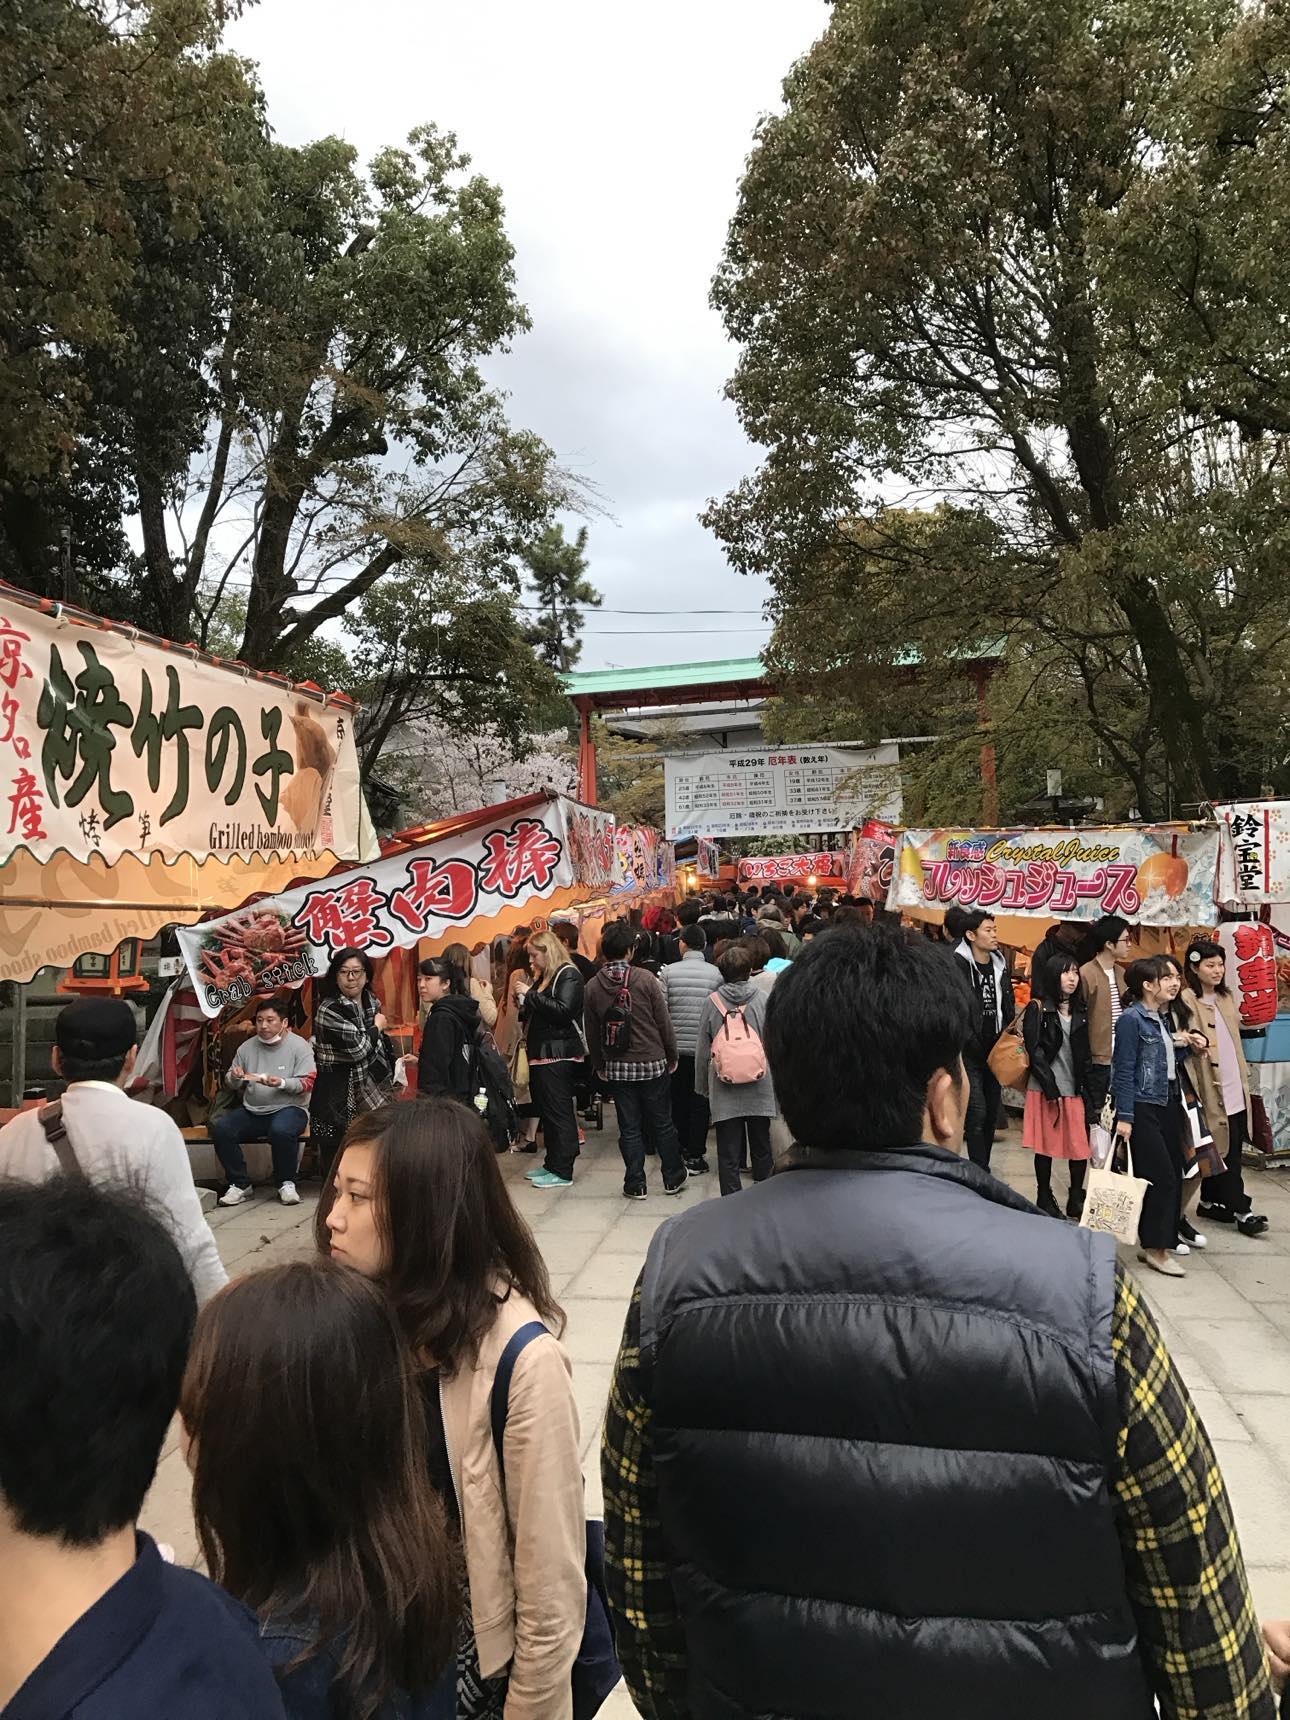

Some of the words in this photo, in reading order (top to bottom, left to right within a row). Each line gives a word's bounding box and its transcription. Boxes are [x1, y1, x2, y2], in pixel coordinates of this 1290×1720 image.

[36, 640, 294, 832] 焼竹の子
[729, 758, 766, 768] 平成29年
[768, 755, 797, 766] 厄年表
[799, 755, 829, 765] (数え年)
[209, 822, 254, 849] Grilled
[257, 823, 293, 849] bamboo
[947, 839, 986, 862] 新食感
[985, 839, 1066, 864] Crystal
[1061, 838, 1121, 867] Juice
[1231, 814, 1264, 890] 鈴宝堂
[745, 851, 834, 878] いちご大福
[291, 818, 563, 960] 蟹肉棒
[921, 860, 1141, 915] フレッシュジュース
[205, 975, 252, 1009] Crab
